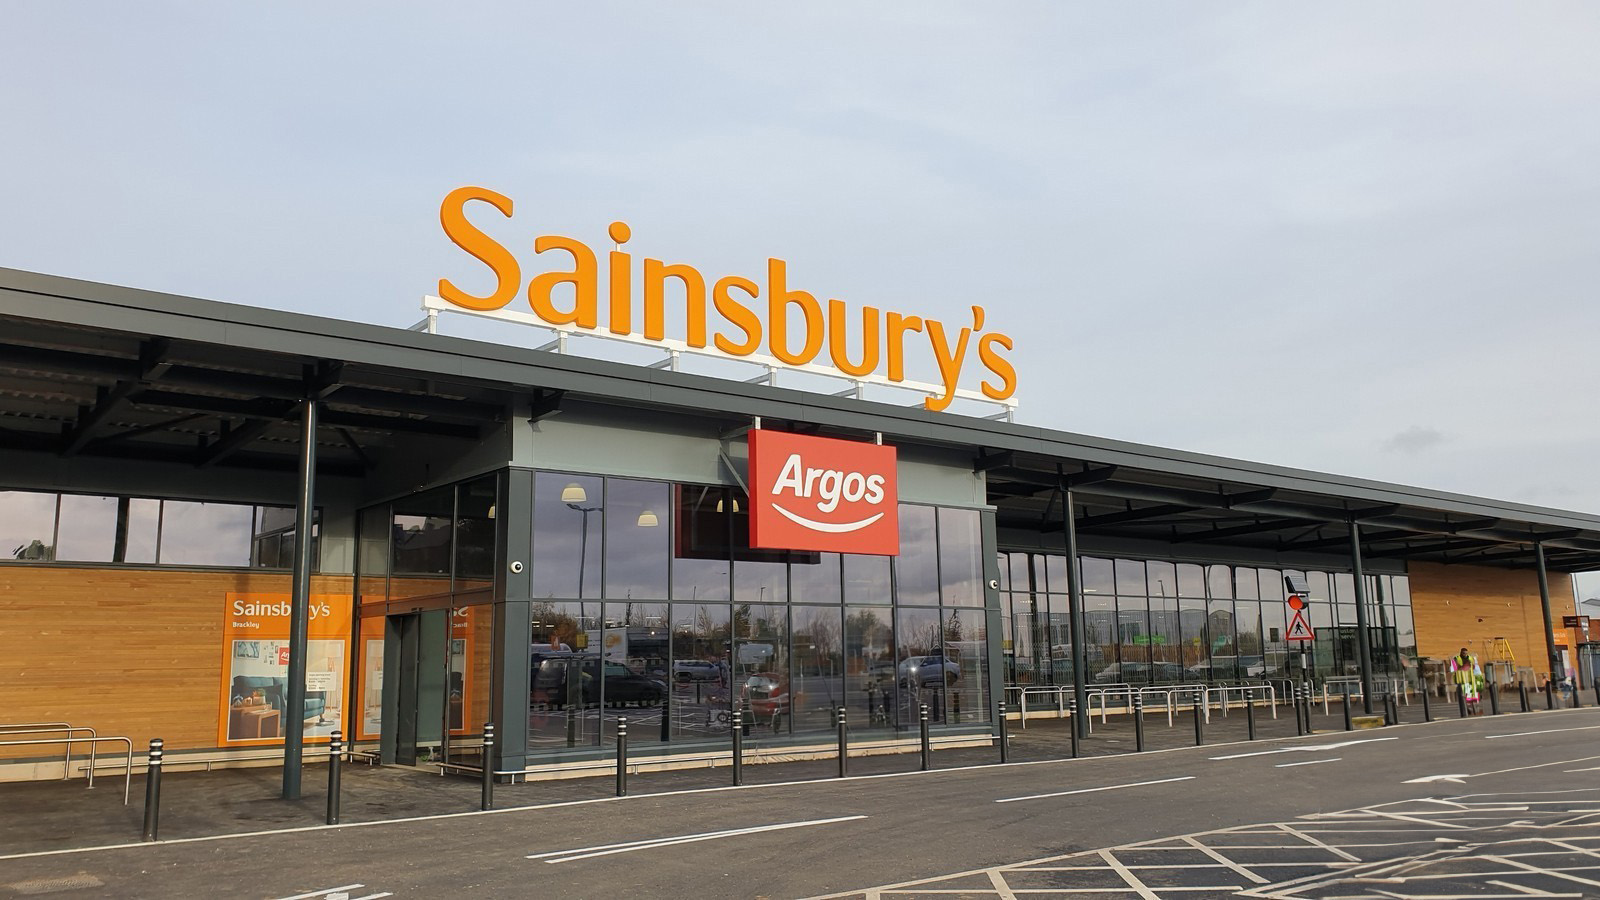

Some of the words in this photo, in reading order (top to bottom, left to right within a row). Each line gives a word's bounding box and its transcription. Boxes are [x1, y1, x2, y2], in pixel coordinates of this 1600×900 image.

[439, 186, 1017, 411] Sainsbury's
[771, 453, 885, 513] Argos
[232, 621, 260, 629] Brackley
[233, 600, 331, 620] Sainsby's
